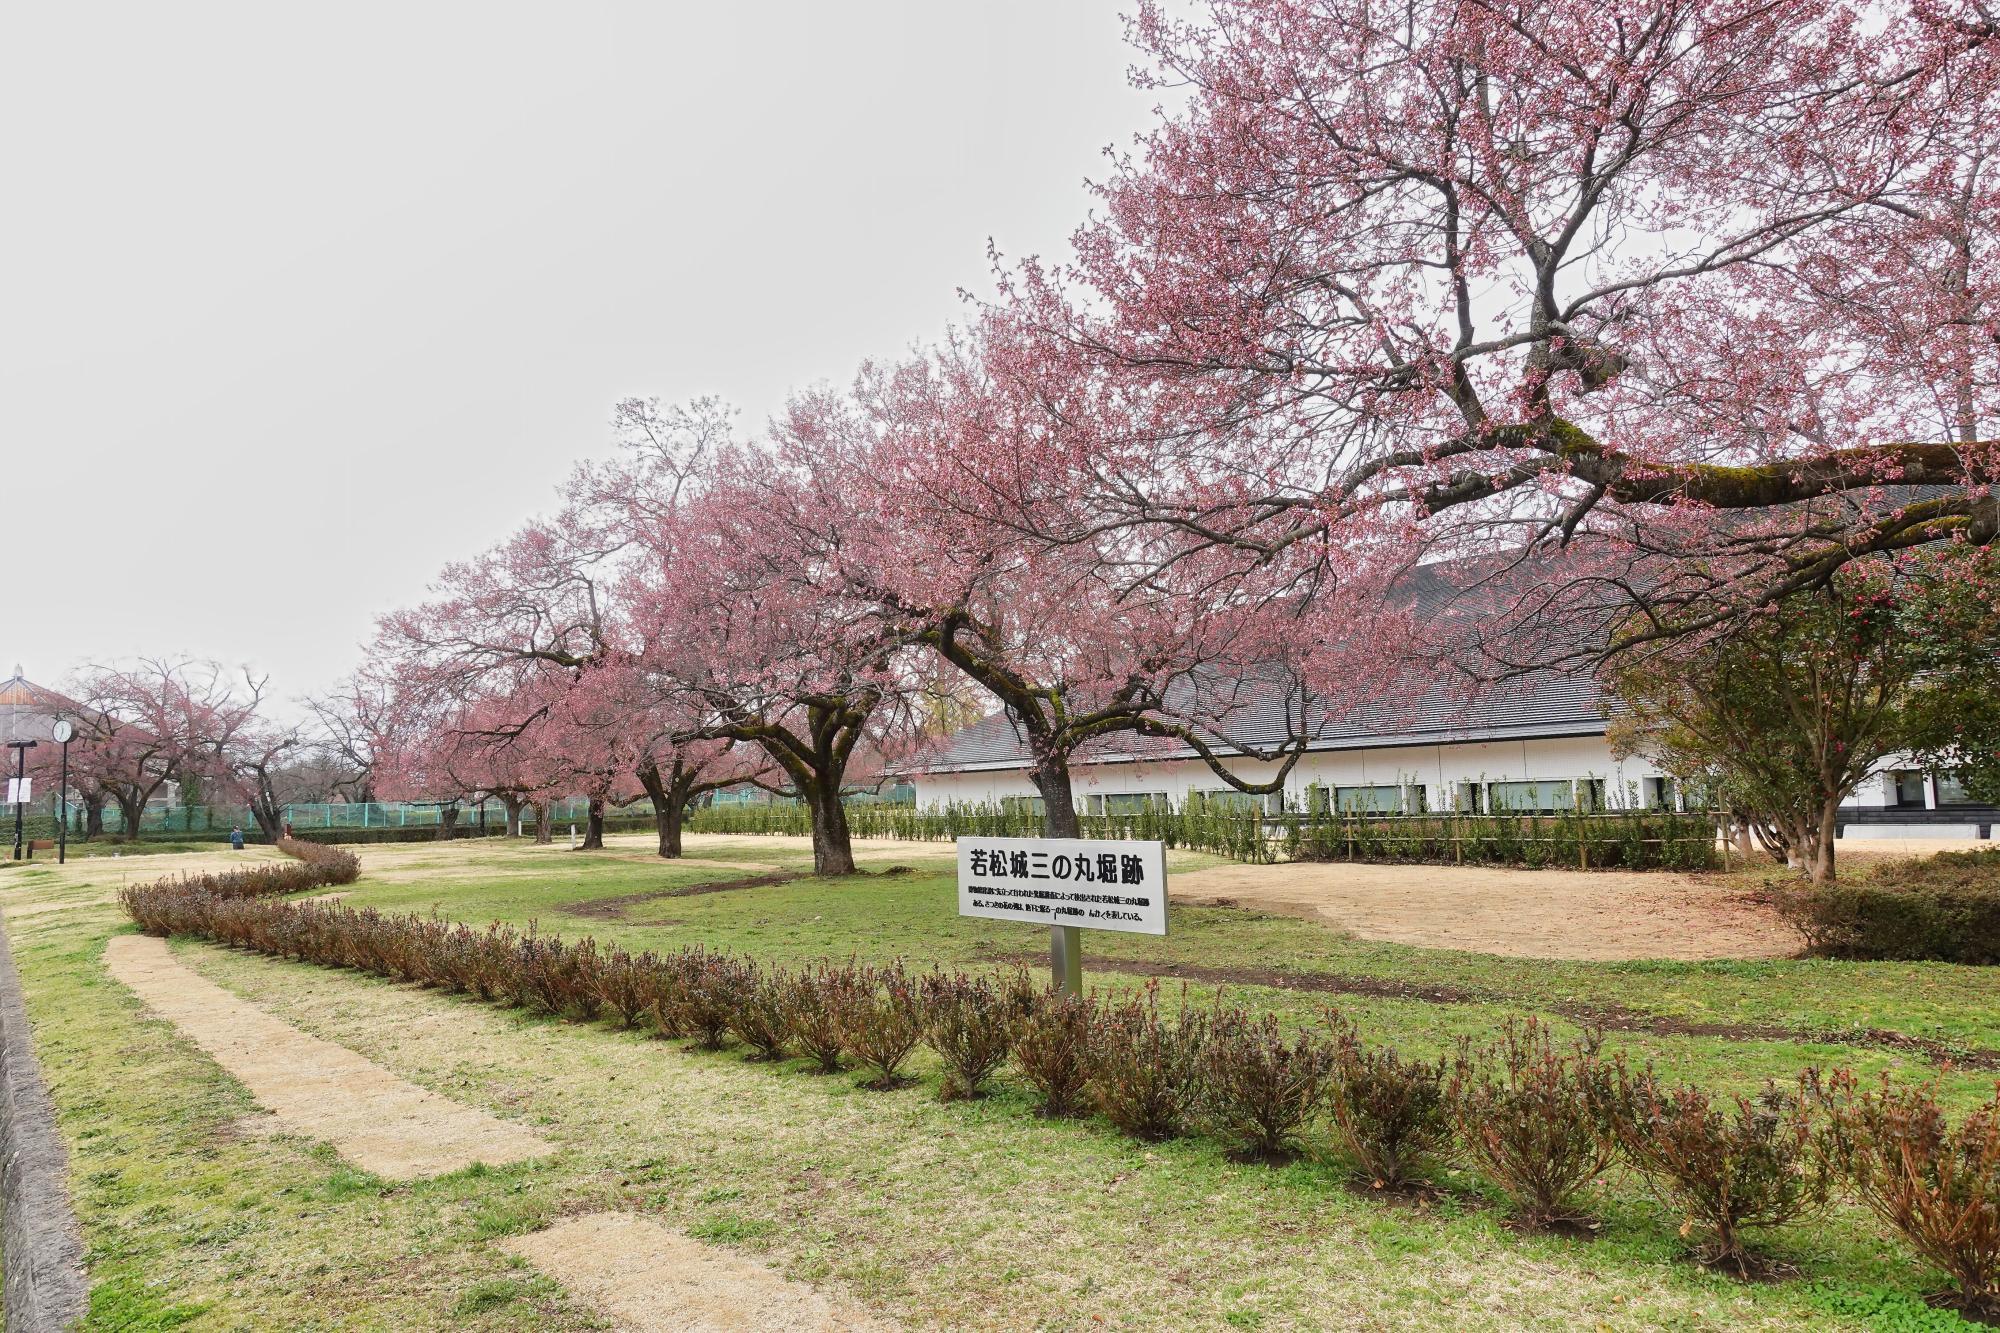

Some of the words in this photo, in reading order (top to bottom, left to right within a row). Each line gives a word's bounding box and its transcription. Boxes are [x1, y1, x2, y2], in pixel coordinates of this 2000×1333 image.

[970, 848, 1144, 885] 若松城三の丸堀跡
